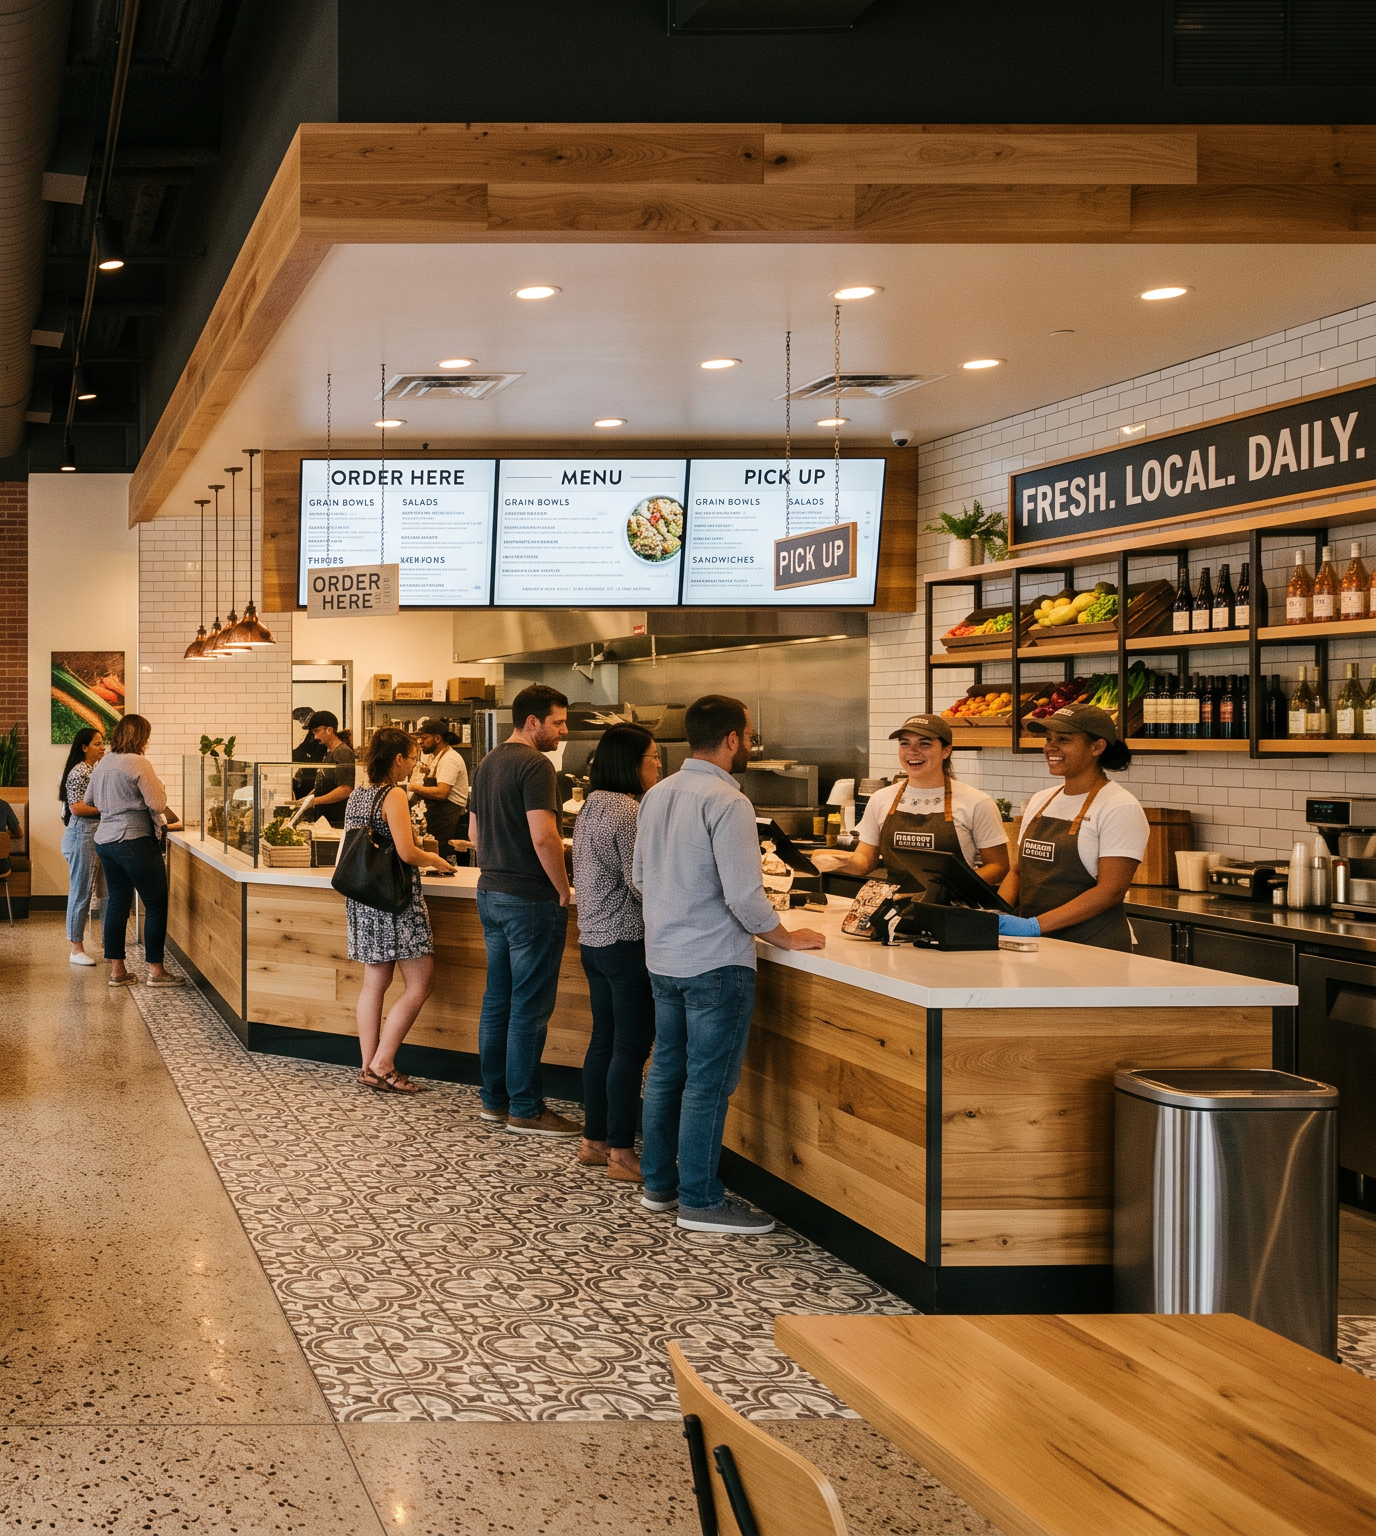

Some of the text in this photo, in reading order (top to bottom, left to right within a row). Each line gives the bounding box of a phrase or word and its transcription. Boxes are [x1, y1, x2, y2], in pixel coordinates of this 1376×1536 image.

[561, 469, 622, 485] MENU
[744, 469, 826, 485] PICK UP
[1022, 411, 1366, 527] FRESH. LOCAL. DAILY.
[331, 469, 465, 486] ORDER HERE
[308, 499, 375, 507] GRAIN BOWLS
[402, 498, 438, 506] SALADS
[504, 498, 570, 506] GRAIN BOWLS
[695, 498, 761, 506] GRAIN BOWLS
[788, 498, 824, 506] SALADS
[692, 556, 755, 564] SANDWICHES
[779, 539, 844, 576] PICK UP
[313, 572, 381, 593] ORDER
[322, 593, 373, 610] HERE
